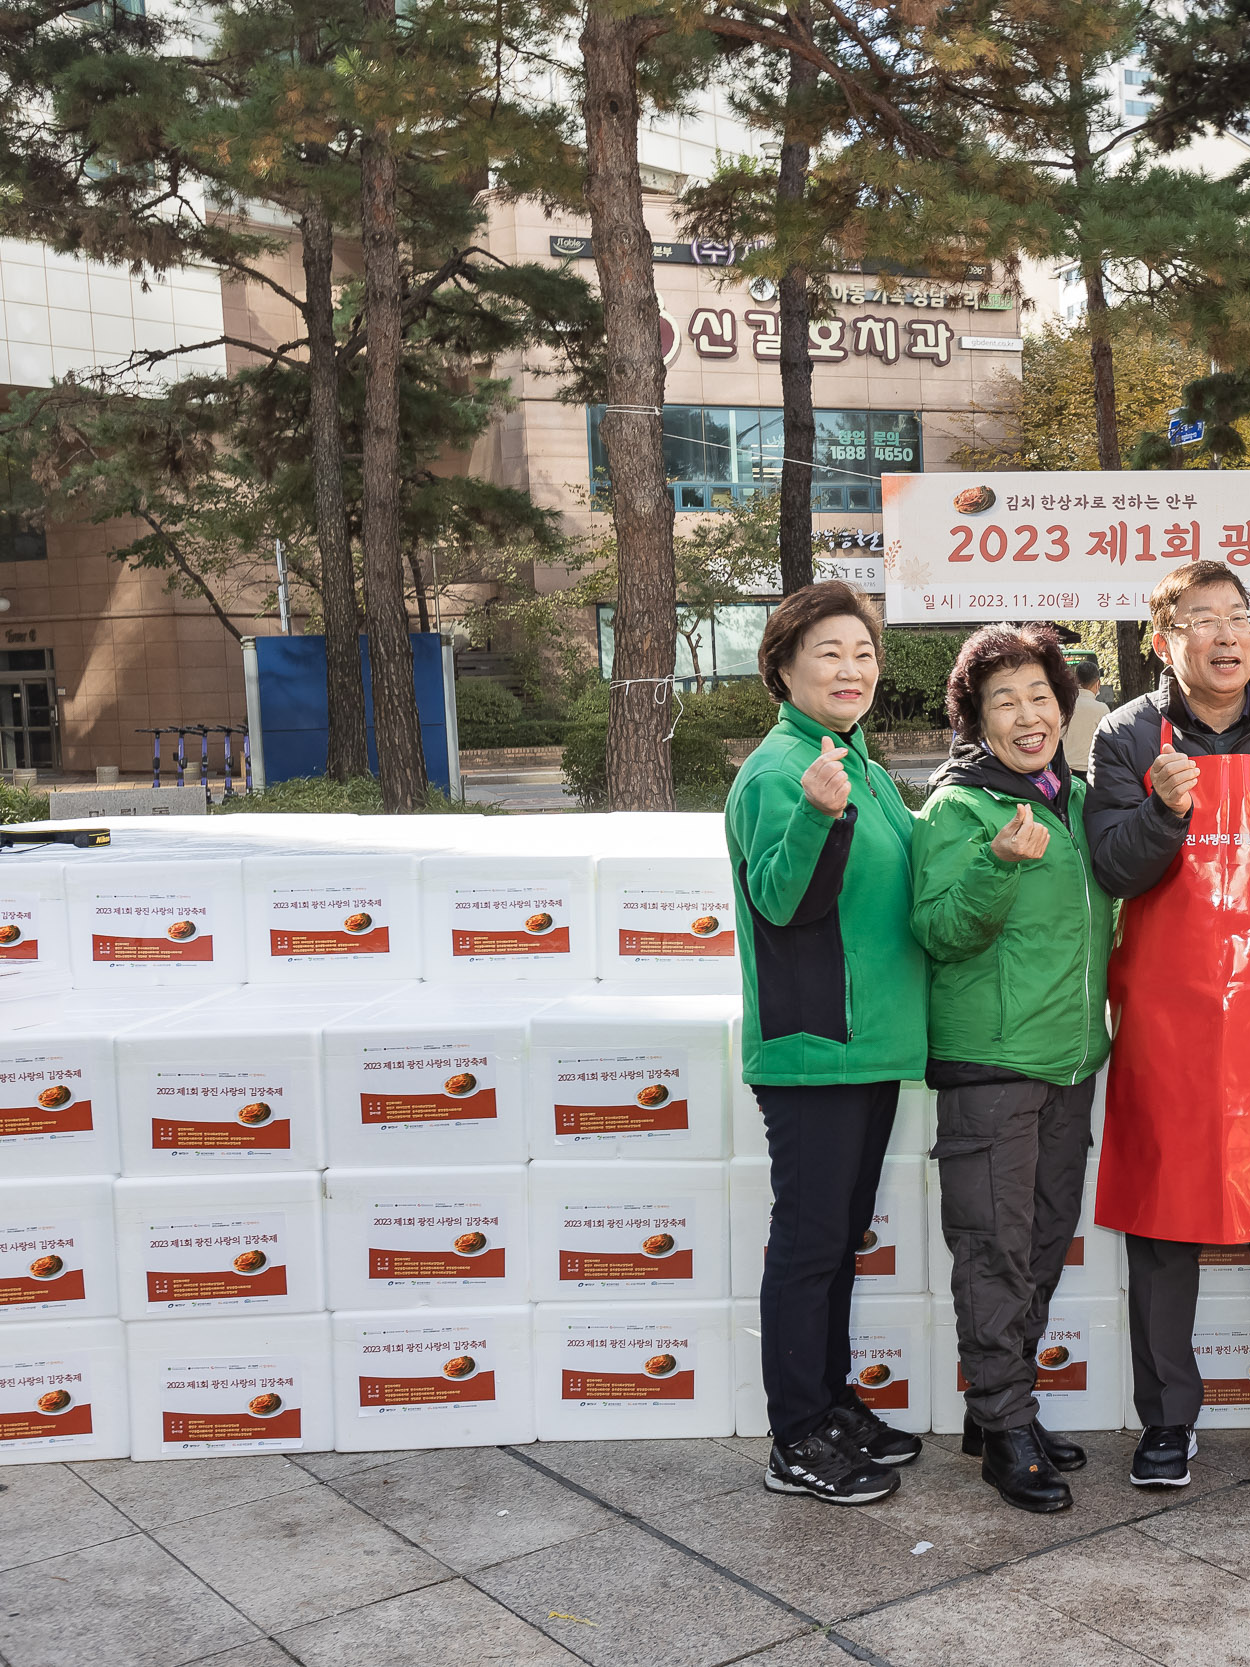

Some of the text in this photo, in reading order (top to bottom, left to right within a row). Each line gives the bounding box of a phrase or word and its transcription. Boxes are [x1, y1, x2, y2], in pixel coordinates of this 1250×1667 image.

[832, 282, 866, 304] 아동
[912, 287, 946, 309] 상담
[873, 430, 901, 446] 문의
[830, 446, 913, 462] 1688 4650
[1006, 492, 1198, 511] 김치 한상자로 전하는 안부
[947, 524, 1071, 563] 2023
[1085, 520, 1201, 567] 제1회
[969, 592, 1080, 609] 2023. 11. 20(월)
[1199, 833, 1230, 846] 사랑의
[291, 901, 309, 909] 제1회
[311, 901, 326, 909] 광진
[328, 900, 350, 908] 사랑의
[353, 899, 381, 908] 김장축제
[472, 901, 490, 909] 제1회
[493, 901, 507, 909] 광진
[509, 900, 531, 908] 사랑의
[533, 899, 562, 908] 김장축제
[640, 902, 658, 910] 제1회
[660, 902, 674, 911] 광진
[676, 902, 698, 911] 사랑의
[701, 903, 729, 911] 김장축제
[113, 907, 132, 915] 제1회
[134, 907, 149, 915] 광진
[151, 907, 173, 916] 사랑의
[176, 907, 206, 916] 김장축제
[364, 1057, 487, 1070] 2023 제1회 광진 사랑의 김장축제
[47, 1069, 82, 1080] 김장축제
[577, 1072, 598, 1081] 제1회
[600, 1071, 617, 1081] 광진
[619, 1070, 644, 1080] 사랑의
[647, 1069, 679, 1079] 김장축제
[176, 1087, 198, 1096] 제1회
[201, 1087, 218, 1096] 광진
[220, 1087, 246, 1096] 사랑의
[249, 1087, 282, 1097] 김장축제
[393, 1217, 415, 1226] 제1회
[417, 1217, 434, 1226] 광진
[436, 1217, 462, 1226] 사랑의
[465, 1217, 498, 1226] 김장축제
[583, 1219, 604, 1228] 제1회
[607, 1219, 623, 1228] 광진
[625, 1219, 650, 1228] 사랑의
[653, 1218, 685, 1228] 김장축제
[150, 1234, 277, 1248] 2023 제1회 광진 사랑의 김장축제
[1049, 1331, 1081, 1340] 김장축제
[383, 1344, 403, 1353] 제1회
[406, 1343, 423, 1352] 광진
[425, 1342, 450, 1351] 사랑의
[453, 1340, 486, 1350] 김장축제
[586, 1339, 607, 1348] 제1회
[609, 1339, 625, 1348] 광진
[628, 1339, 652, 1348] 사랑의
[656, 1339, 688, 1348] 김장축제
[870, 1349, 902, 1358] 김장축제
[1215, 1345, 1231, 1355] 광진
[187, 1380, 208, 1389] 제1회
[211, 1379, 228, 1389] 광진
[230, 1379, 256, 1388] 사랑의
[259, 1378, 293, 1388] 김장축제
